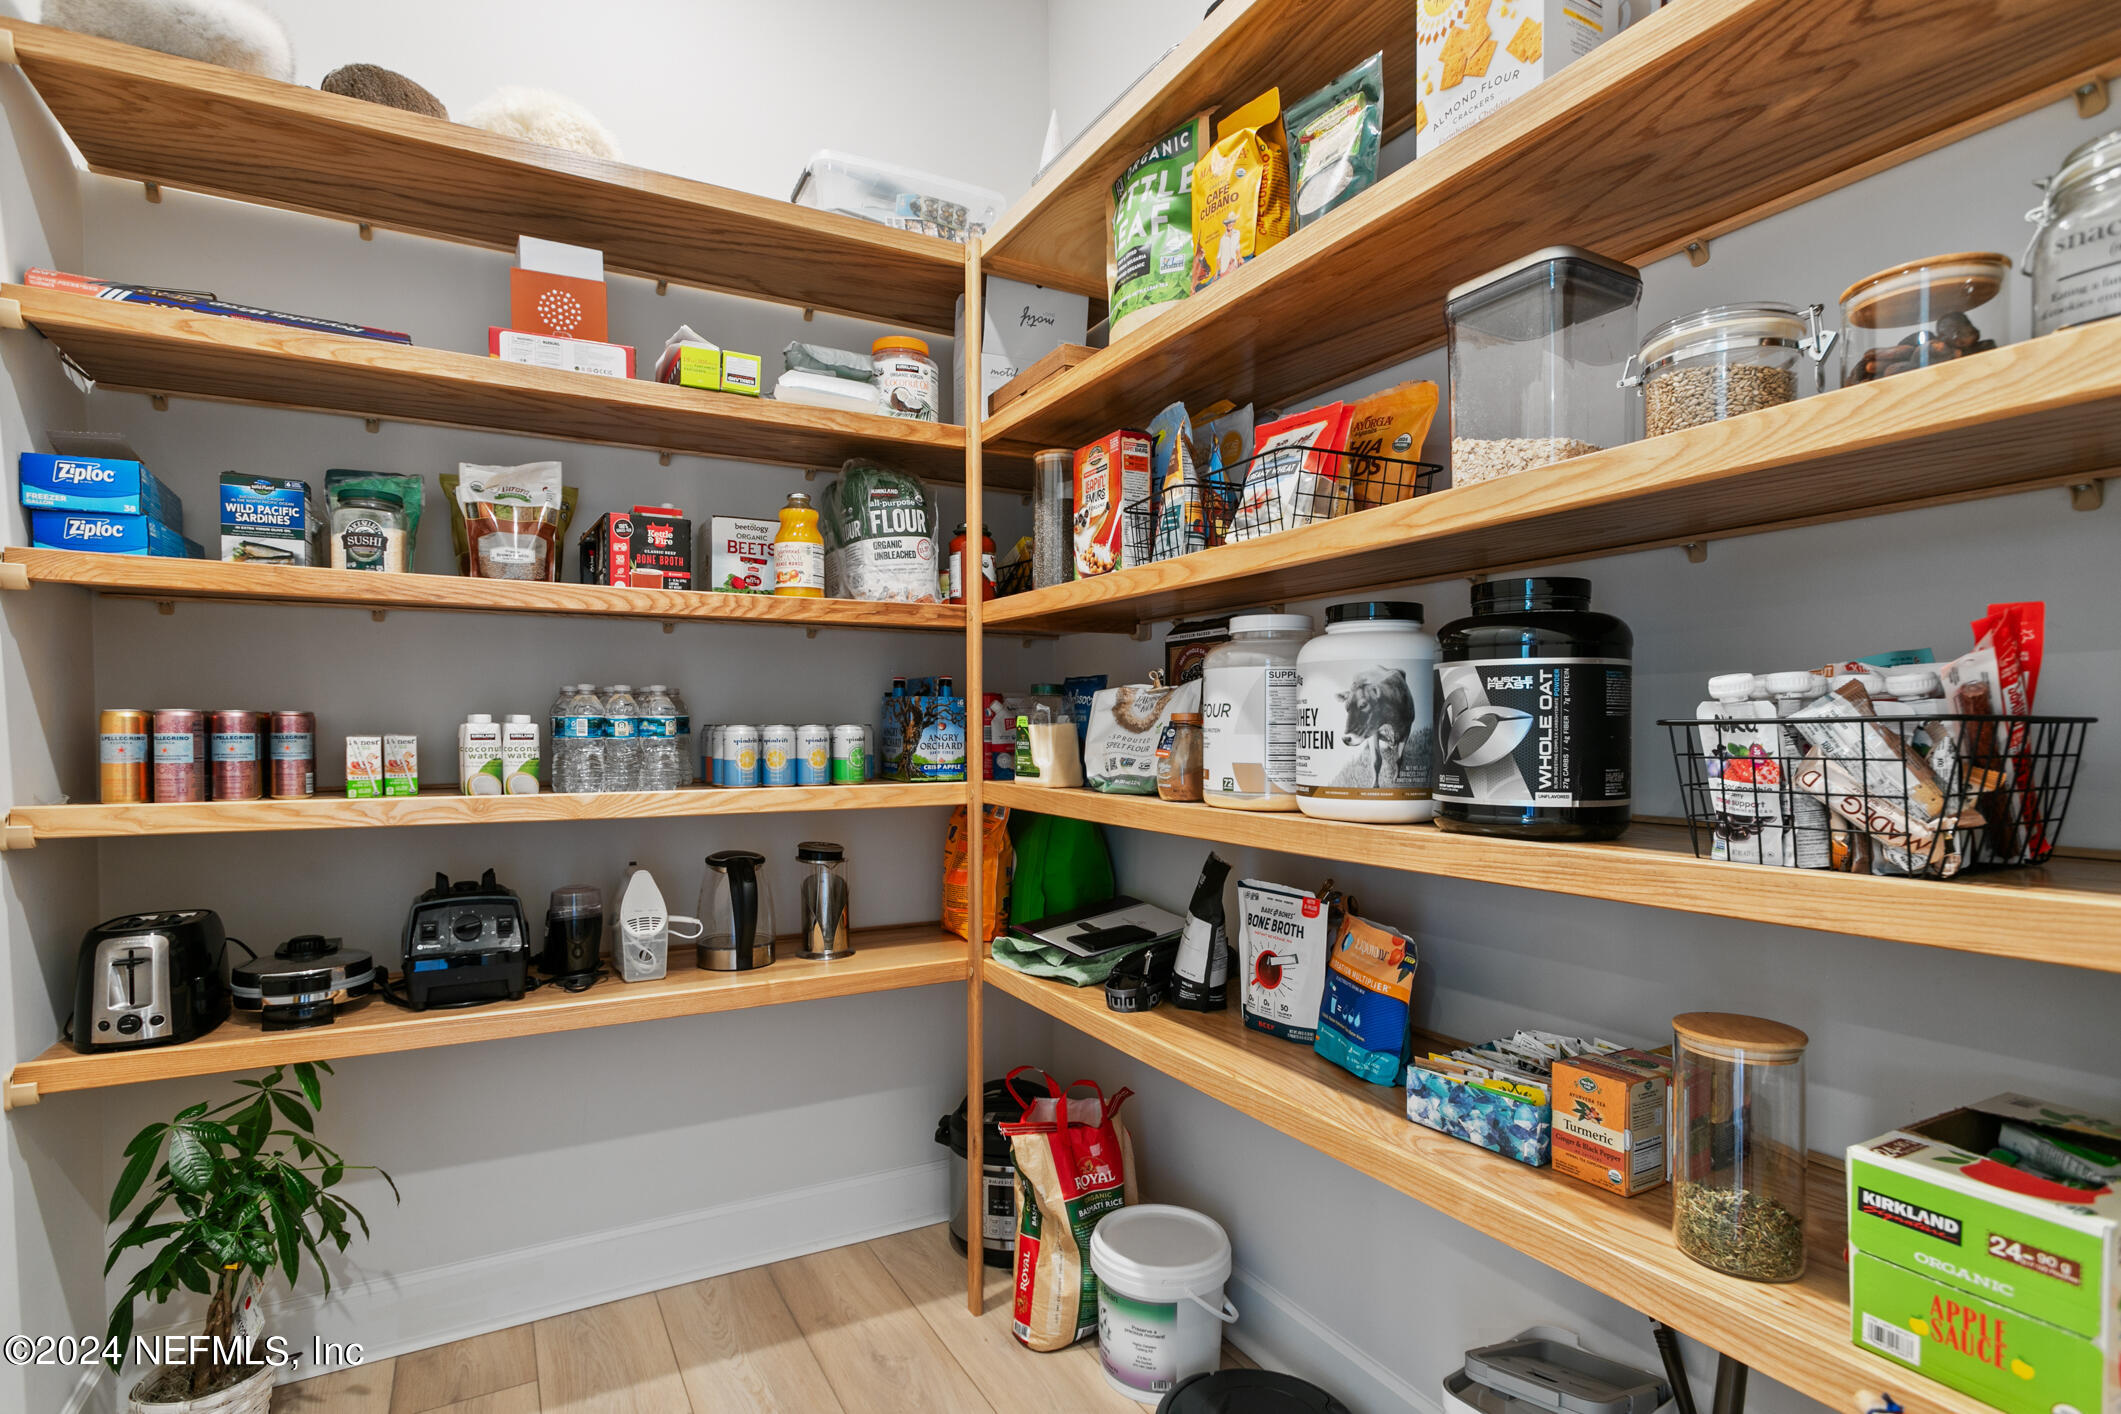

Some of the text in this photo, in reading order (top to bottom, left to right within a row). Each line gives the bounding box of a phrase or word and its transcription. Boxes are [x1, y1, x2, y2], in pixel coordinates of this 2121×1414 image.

[1433, 68, 1521, 133] ALMOND FLOUR
[1452, 92, 1496, 125] CRACKERS
[1126, 131, 1190, 181] ORGANIC
[1258, 153, 1271, 208] CUBANO
[1206, 183, 1230, 205] CAFE
[1199, 191, 1240, 221] CUBANO
[58, 463, 115, 484] Ziploc
[25, 492, 67, 502] FREEZER
[870, 487, 899, 495] KIRKLAND
[225, 502, 300, 517] WILD PACIFIC
[869, 497, 916, 508] all-purpose
[235, 512, 291, 526] SARDINES
[735, 523, 769, 533] beetology
[869, 507, 927, 534] FLOUR
[69, 519, 123, 540] Ziploc
[647, 529, 674, 539] Kettle
[736, 532, 768, 541] ORGANIC
[346, 535, 383, 547] SUSHI
[647, 536, 674, 546] & Fire
[727, 539, 775, 557] BEETS
[872, 539, 903, 551] ORGANIC
[636, 553, 684, 567] BONE BROTH
[873, 550, 918, 561] UNBLEACHED
[1487, 676, 1533, 684] MUSCLE
[1487, 682, 1533, 690] FEAST
[1562, 667, 1570, 696] PROTEIN
[1562, 697, 1571, 706] 7g
[1539, 669, 1553, 790] WHOLE OAT
[1562, 715, 1570, 735] FIBER
[763, 737, 789, 745] spindrift
[920, 742, 963, 750] ORCHARD
[928, 733, 959, 742] ANGRY
[1106, 741, 1151, 753] SPELT FLOUR
[1562, 735, 1571, 745] 4g
[1562, 753, 1570, 777] CARBS
[1223, 778, 1234, 787] 72
[1562, 777, 1571, 790] 27g
[1260, 905, 1297, 921] BARE BONES
[1247, 912, 1305, 939] BONE BROTH
[1351, 969, 1389, 994] MULTIPLIER
[1280, 1003, 1289, 1013] 50
[1562, 1117, 1614, 1146] Turmeric
[1555, 1132, 1575, 1146] Ginger
[1581, 1142, 1600, 1155] Black
[1599, 1148, 1622, 1164] Pepper
[1073, 1169, 1117, 1192] ROYAL
[1078, 1197, 1125, 1218] BASMATI RICE
[1862, 1190, 1960, 1235] KIRKLAND
[1862, 1204, 1959, 1243] Signature
[1019, 1250, 1031, 1292] ROYAL
[2035, 1251, 2059, 1270] 90
[2060, 1263, 2073, 1278] g
[1913, 1251, 2016, 1298] ORGANIC
[1929, 1294, 2009, 1346] APPLE
[1929, 1316, 2009, 1372] SAUCE
